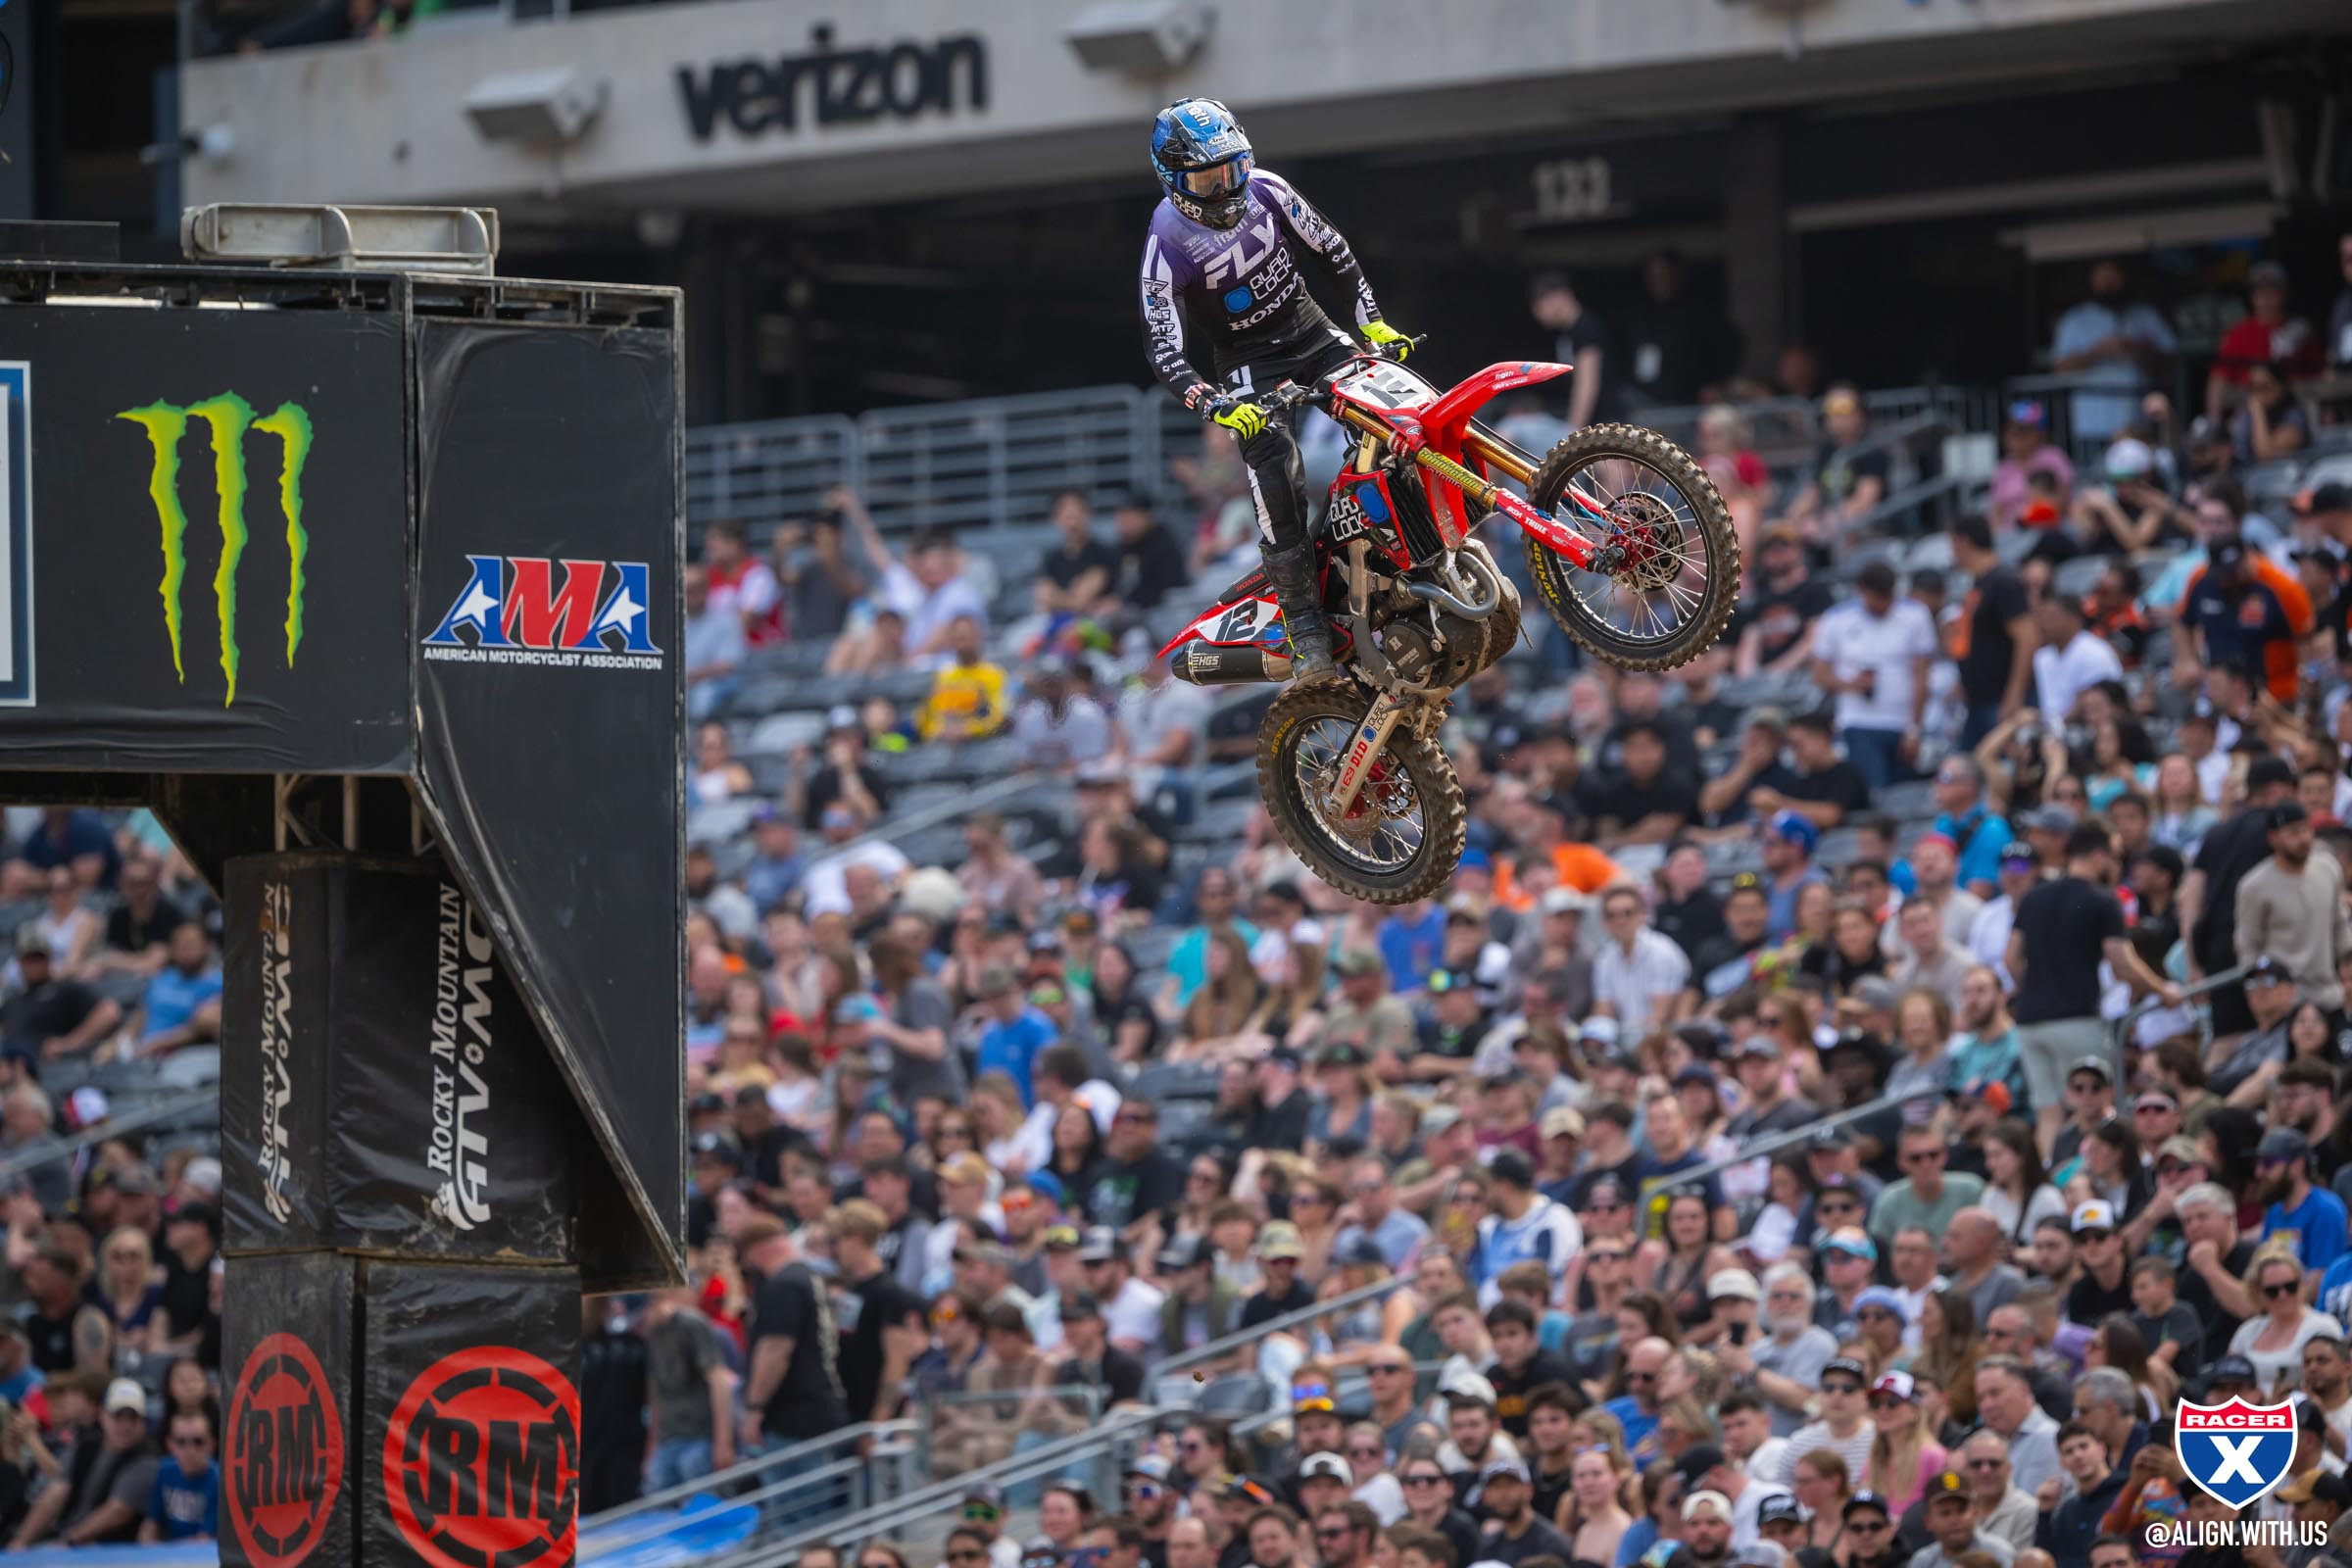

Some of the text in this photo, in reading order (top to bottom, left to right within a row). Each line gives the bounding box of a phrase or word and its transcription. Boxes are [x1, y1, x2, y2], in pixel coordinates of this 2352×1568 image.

[676, 22, 987, 141] verizon
[1203, 212, 1275, 290] FLY
[1250, 247, 1288, 290] QUAD
[1253, 253, 1293, 300] LOCK
[1149, 309, 1170, 319] HGS
[1151, 323, 1175, 333] MTF
[1330, 495, 1359, 522] QUAD
[1524, 516, 1547, 535] THULE
[1331, 512, 1365, 542] LOCK
[1236, 573, 1265, 592] HONDA
[420, 555, 664, 654] AMA
[1214, 599, 1258, 643] 12
[423, 648, 662, 670] AMERICAN MOTORCYCLIST ASSOCIATION
[1198, 655, 1220, 666] HGS
[1271, 716, 1297, 756] DUNLOP
[1349, 741, 1368, 768] DID
[427, 883, 461, 1175] ROCKY MOUNTAIN
[258, 1064, 276, 1174] ROCKY
